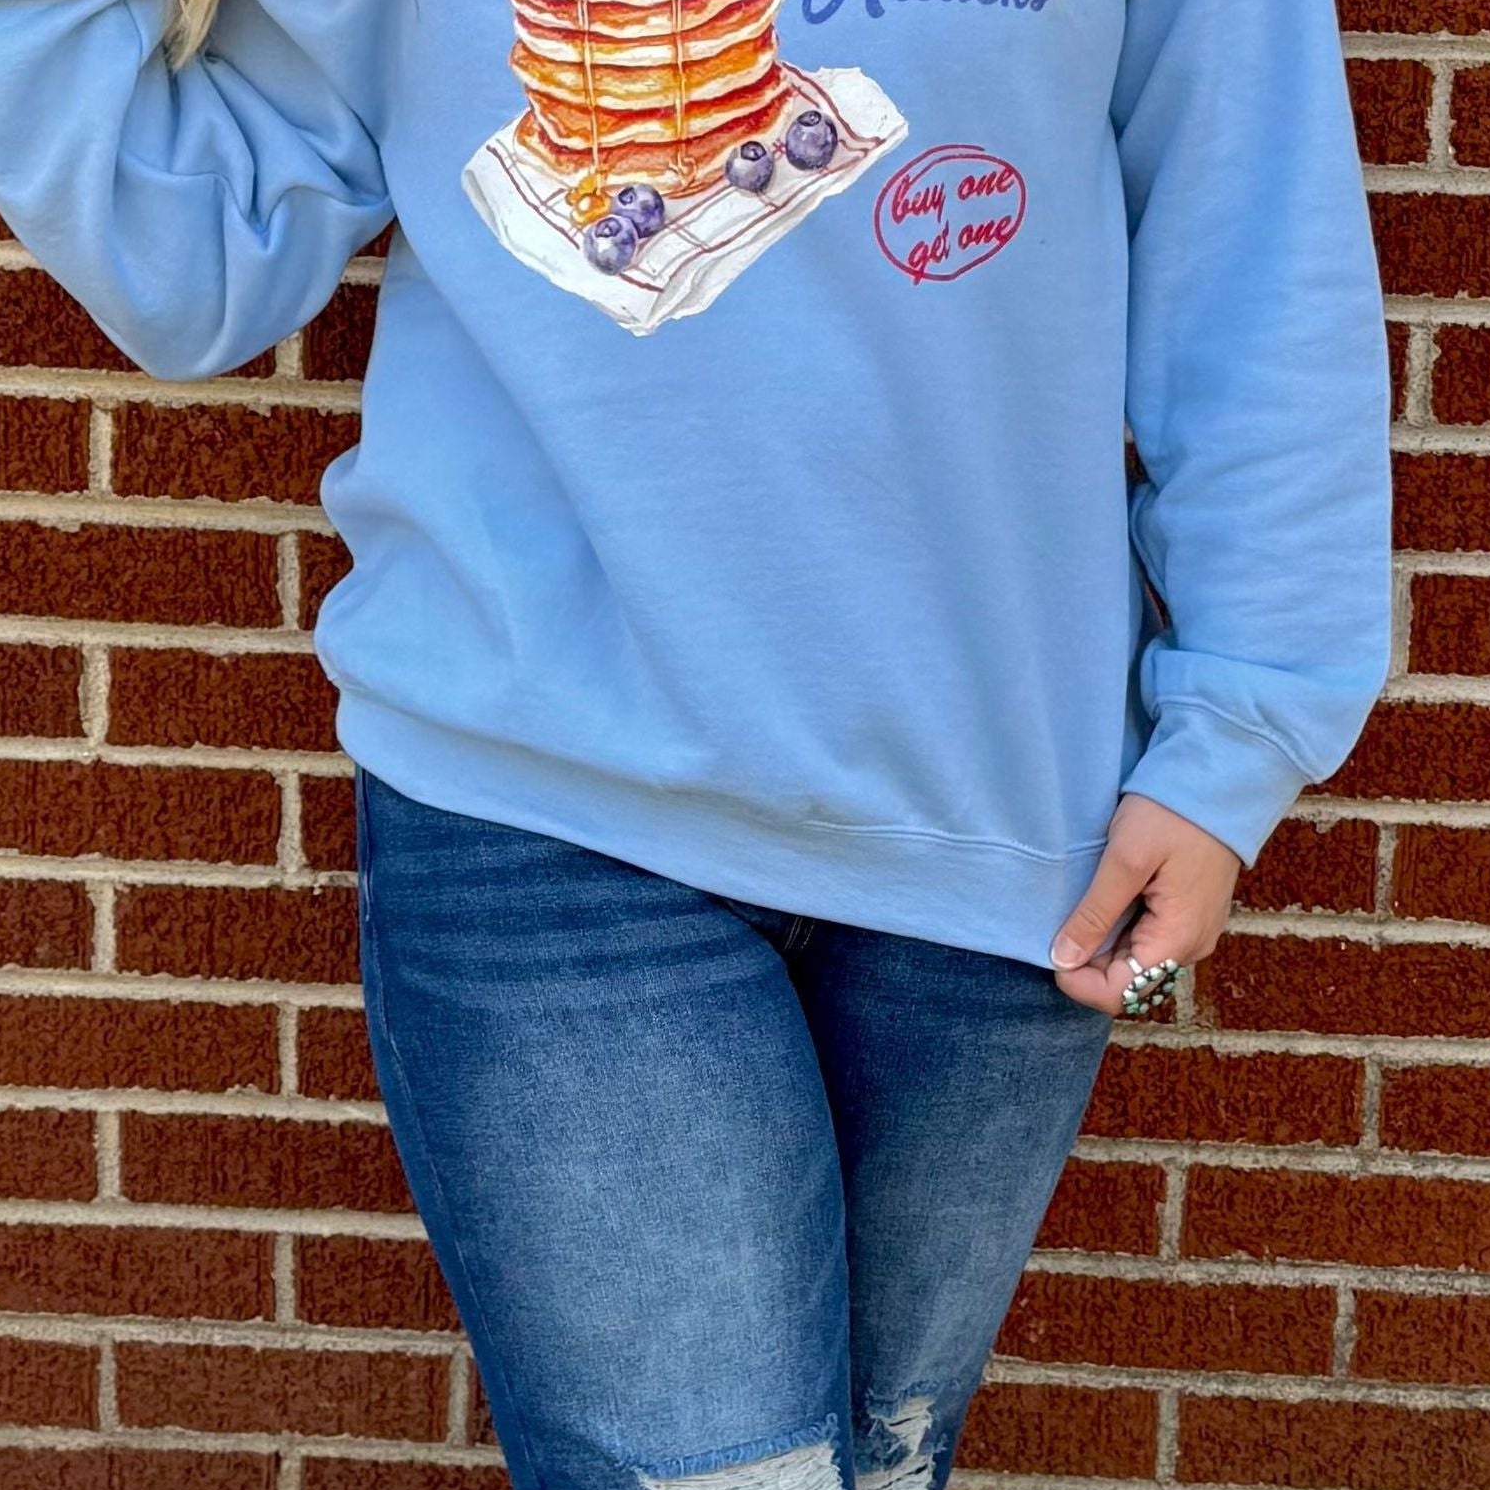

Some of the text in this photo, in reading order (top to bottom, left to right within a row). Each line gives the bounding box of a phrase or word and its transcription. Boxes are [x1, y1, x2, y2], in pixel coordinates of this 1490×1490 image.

[891, 167, 1015, 225] buy one
[907, 214, 1012, 286] get one
